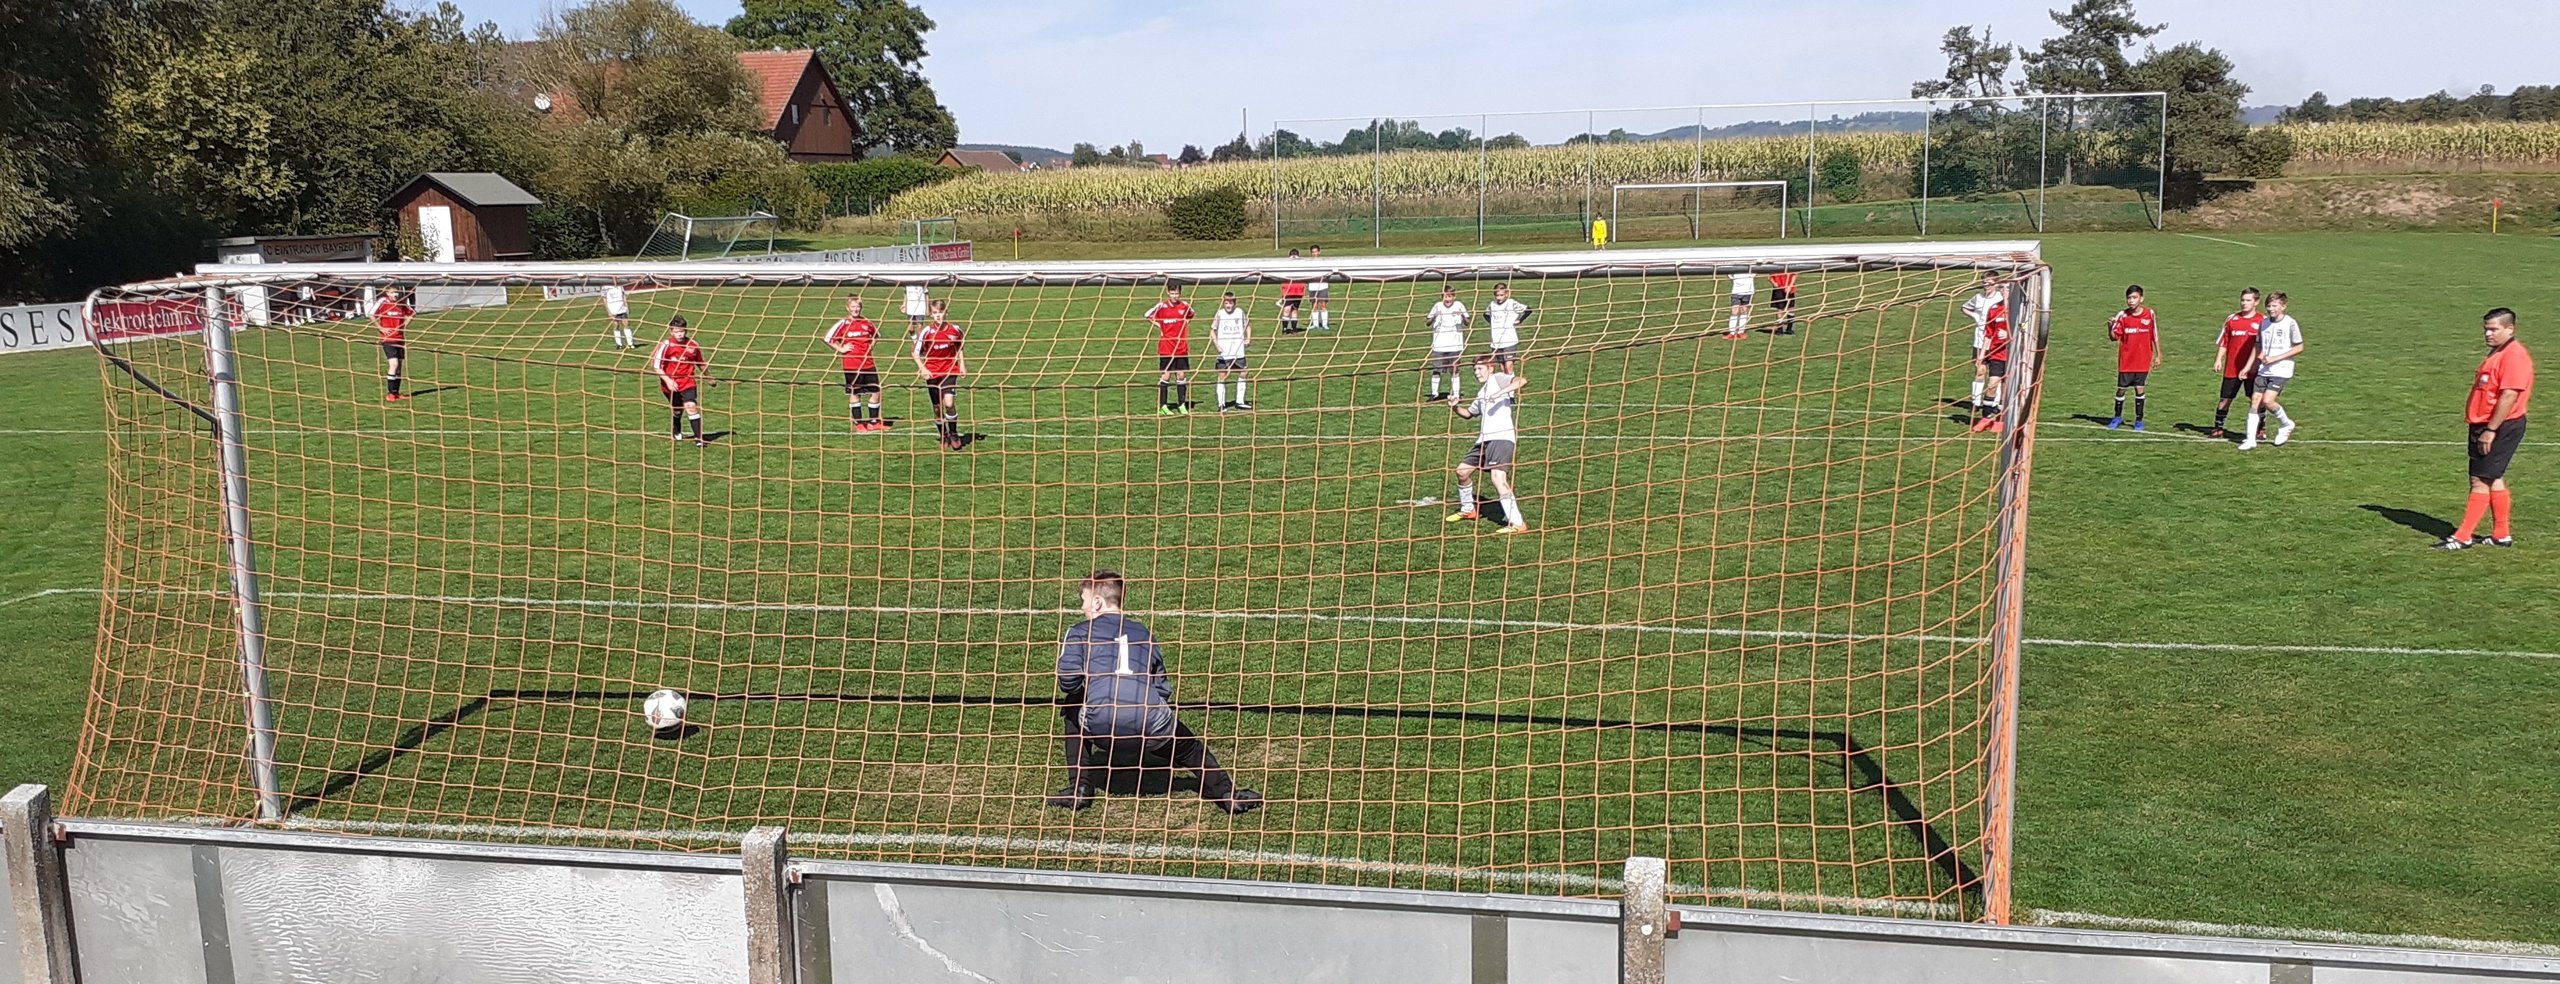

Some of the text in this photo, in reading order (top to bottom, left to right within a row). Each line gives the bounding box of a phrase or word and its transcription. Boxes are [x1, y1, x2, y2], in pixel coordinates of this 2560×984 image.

[275, 243, 321, 256] EINTRACHT
[323, 241, 364, 253] BAYREUTH
[1, 308, 75, 348] SES
[1114, 634, 1134, 675] 1
